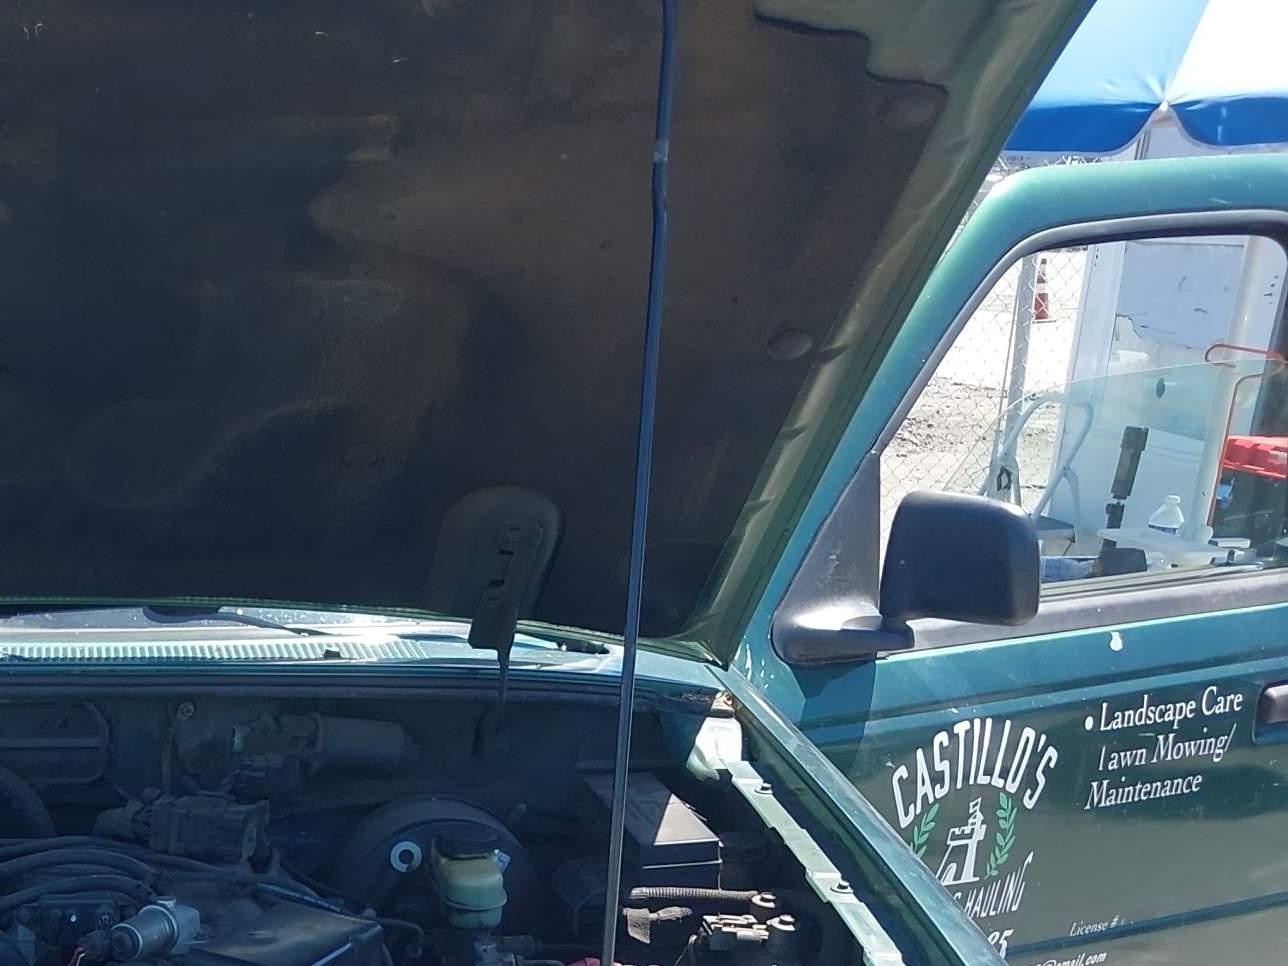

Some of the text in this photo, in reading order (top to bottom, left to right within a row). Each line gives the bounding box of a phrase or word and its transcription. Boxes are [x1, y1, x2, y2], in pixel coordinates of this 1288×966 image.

[1100, 686, 1243, 730] Landscape Care
[892, 718, 1058, 829] CASTILLO'S
[1083, 774, 1203, 810] Maintenance
[1070, 920, 1109, 937] License
